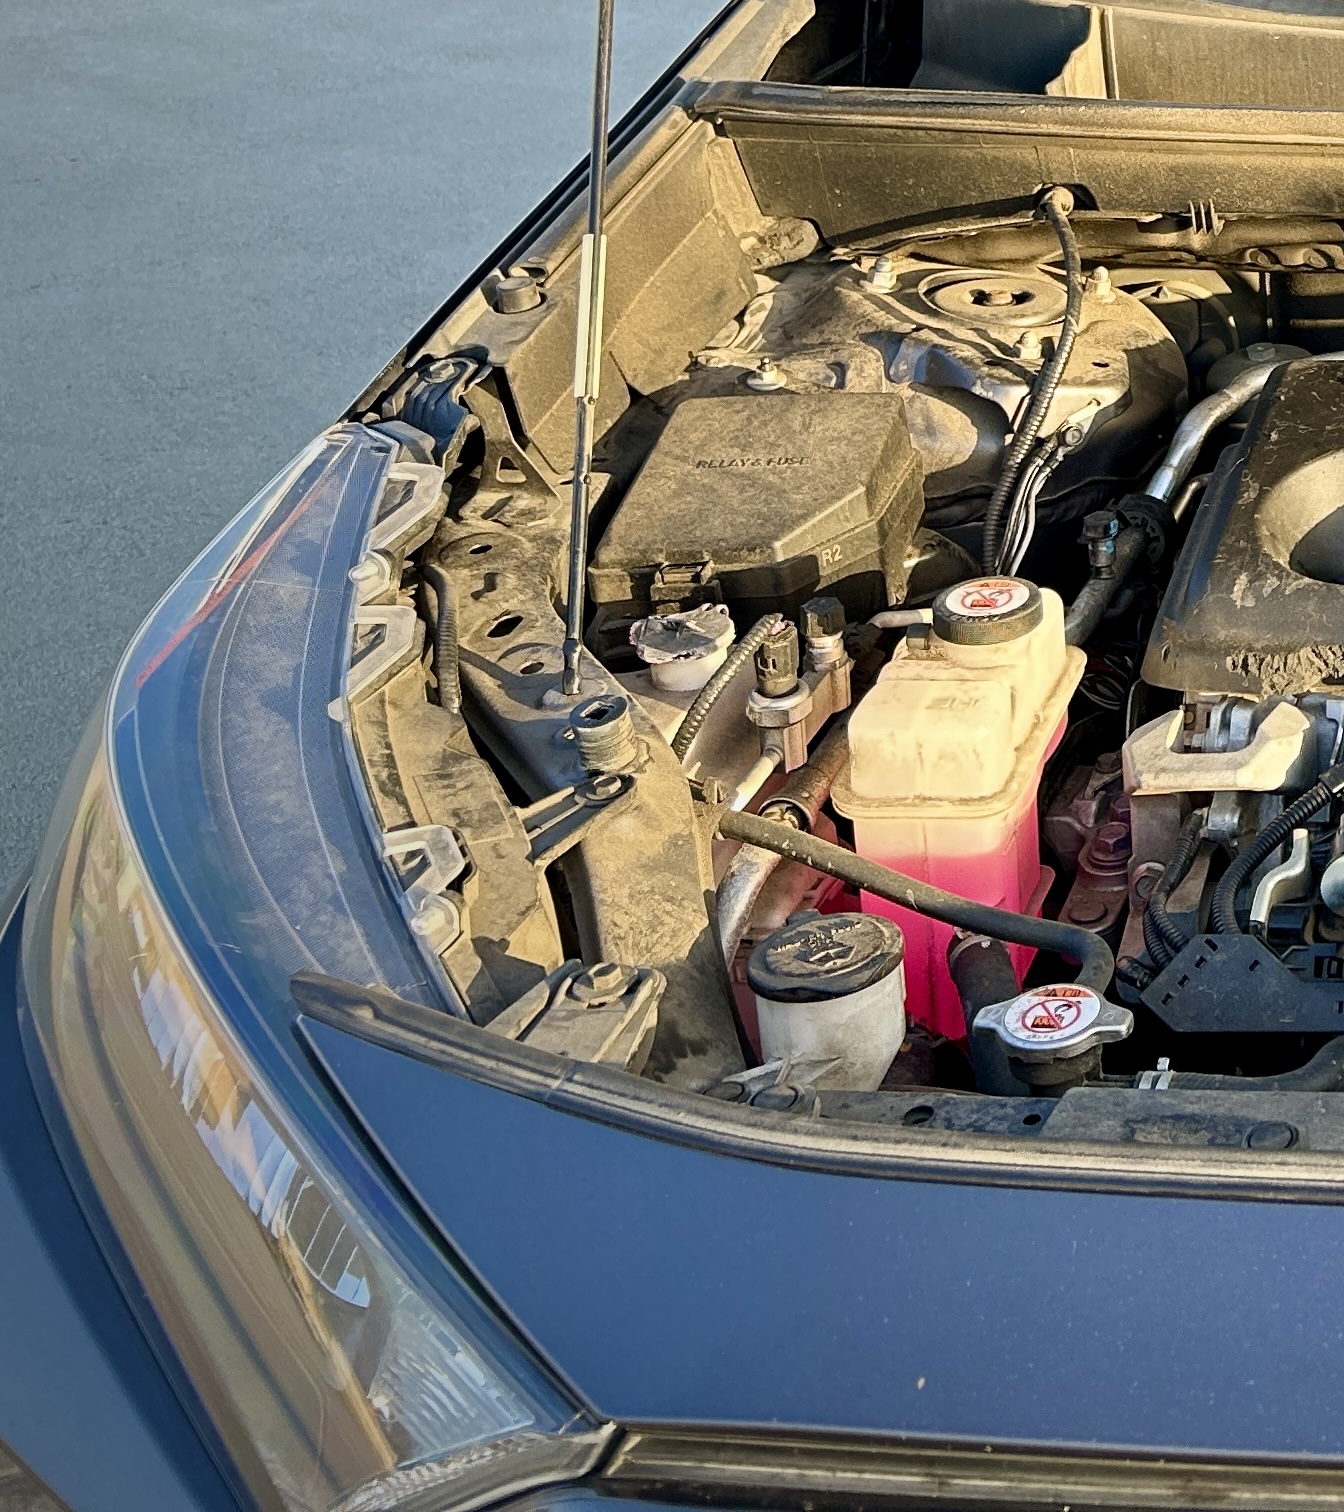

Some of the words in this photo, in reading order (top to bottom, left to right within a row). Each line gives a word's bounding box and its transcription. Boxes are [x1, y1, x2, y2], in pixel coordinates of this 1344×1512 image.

[695, 458, 750, 469] RELAY
[751, 458, 763, 467] &
[766, 456, 812, 467] FUSE
[821, 544, 843, 567] R2
